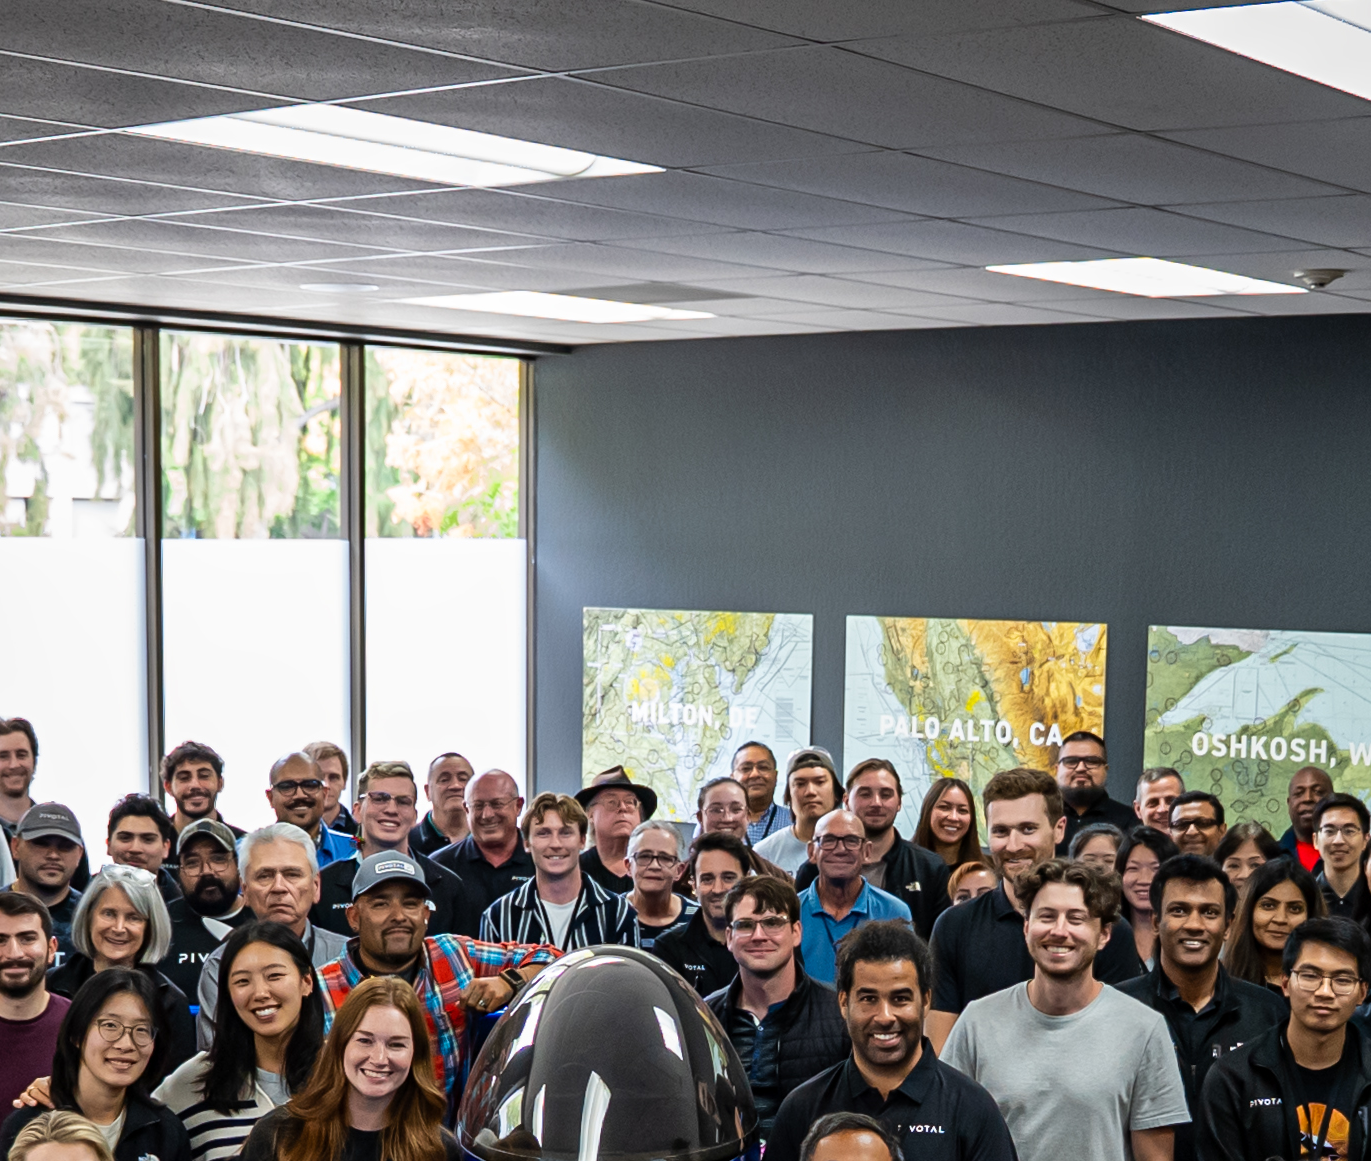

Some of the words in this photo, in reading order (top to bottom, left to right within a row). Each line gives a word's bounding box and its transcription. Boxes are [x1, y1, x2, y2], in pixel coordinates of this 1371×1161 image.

[631, 701, 721, 731] MILTON,
[728, 705, 758, 729] DE
[879, 714, 940, 740] PALO
[948, 718, 1020, 748] ALTO,
[1029, 722, 1064, 747] CA
[1191, 732, 1337, 769] OSHKOSH,
[1249, 1098, 1283, 1108] PIVOTA
[897, 1124, 947, 1135] VOTAL
